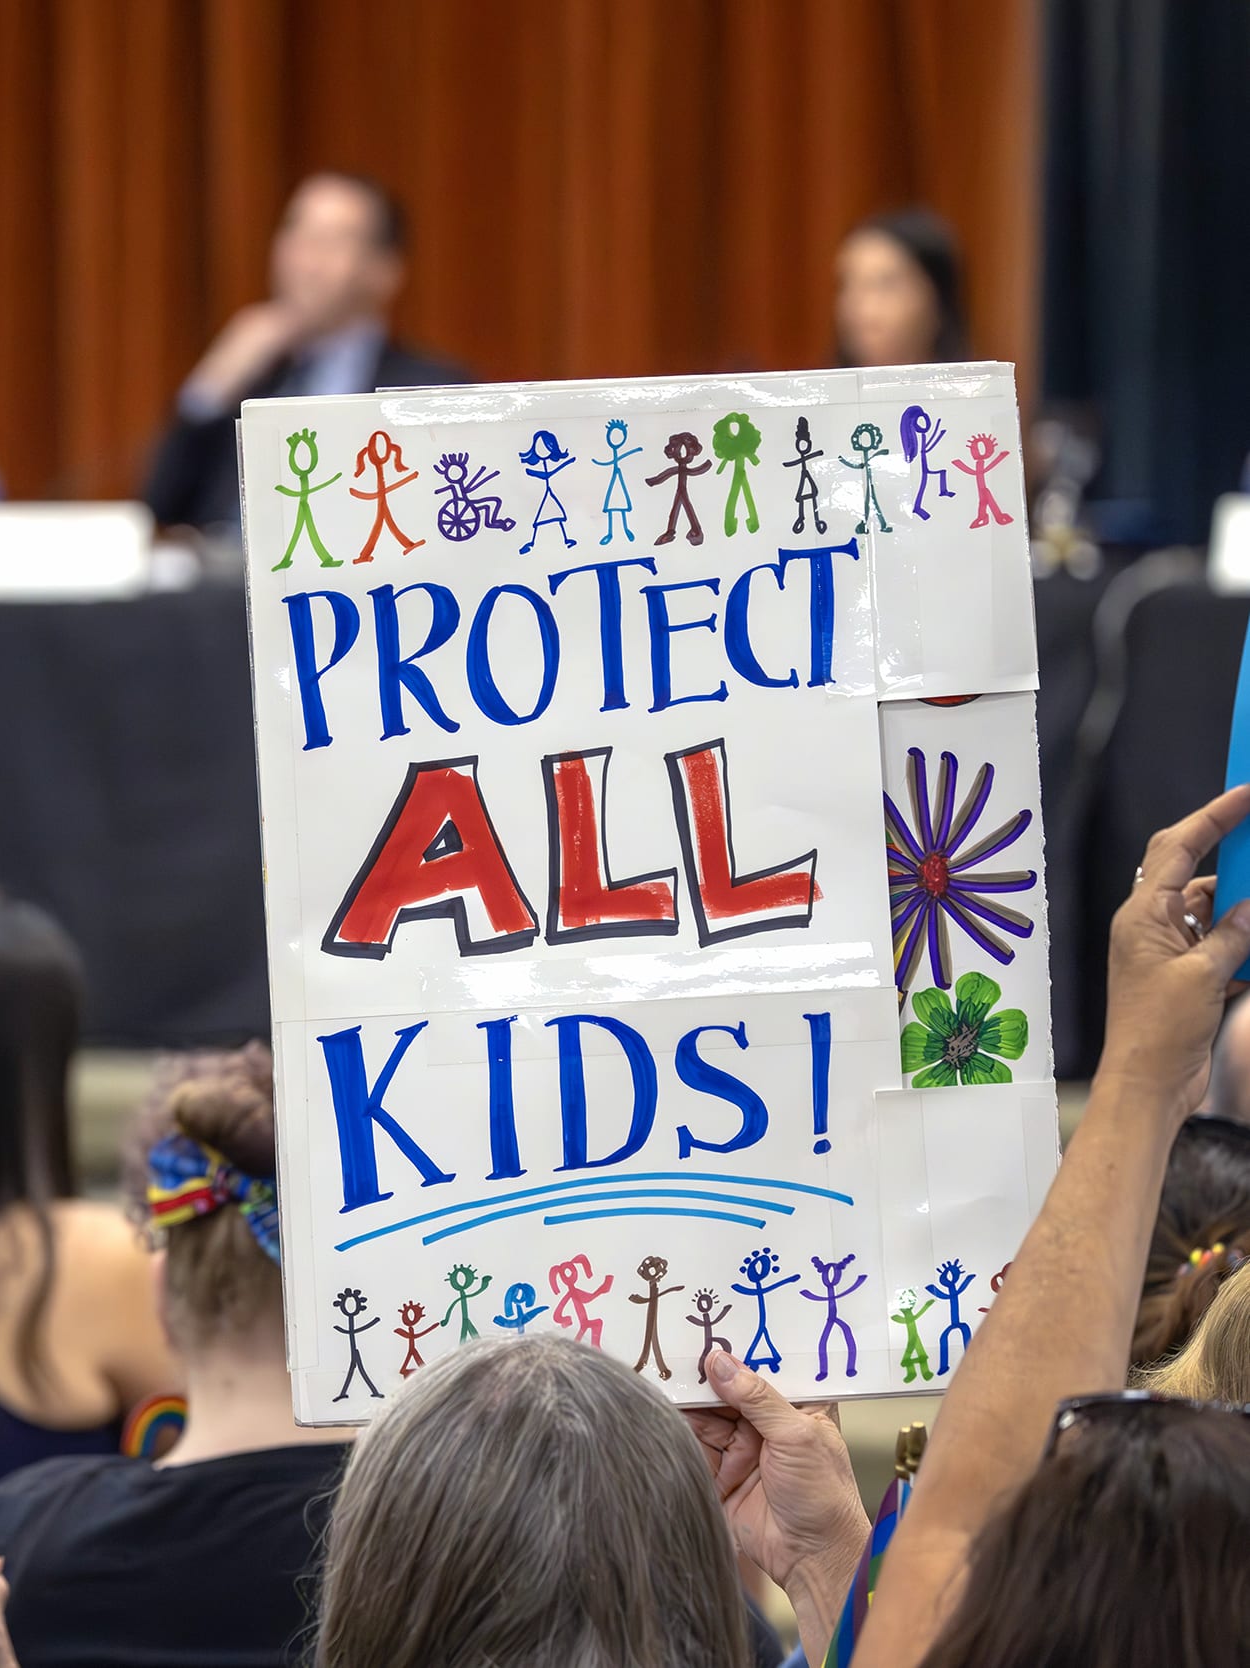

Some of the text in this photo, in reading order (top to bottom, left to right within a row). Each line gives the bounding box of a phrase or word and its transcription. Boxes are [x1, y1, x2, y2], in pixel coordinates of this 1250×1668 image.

[282, 538, 860, 750] PROTECT
[321, 737, 820, 960] ALL
[317, 1012, 832, 1214] KIDS!
